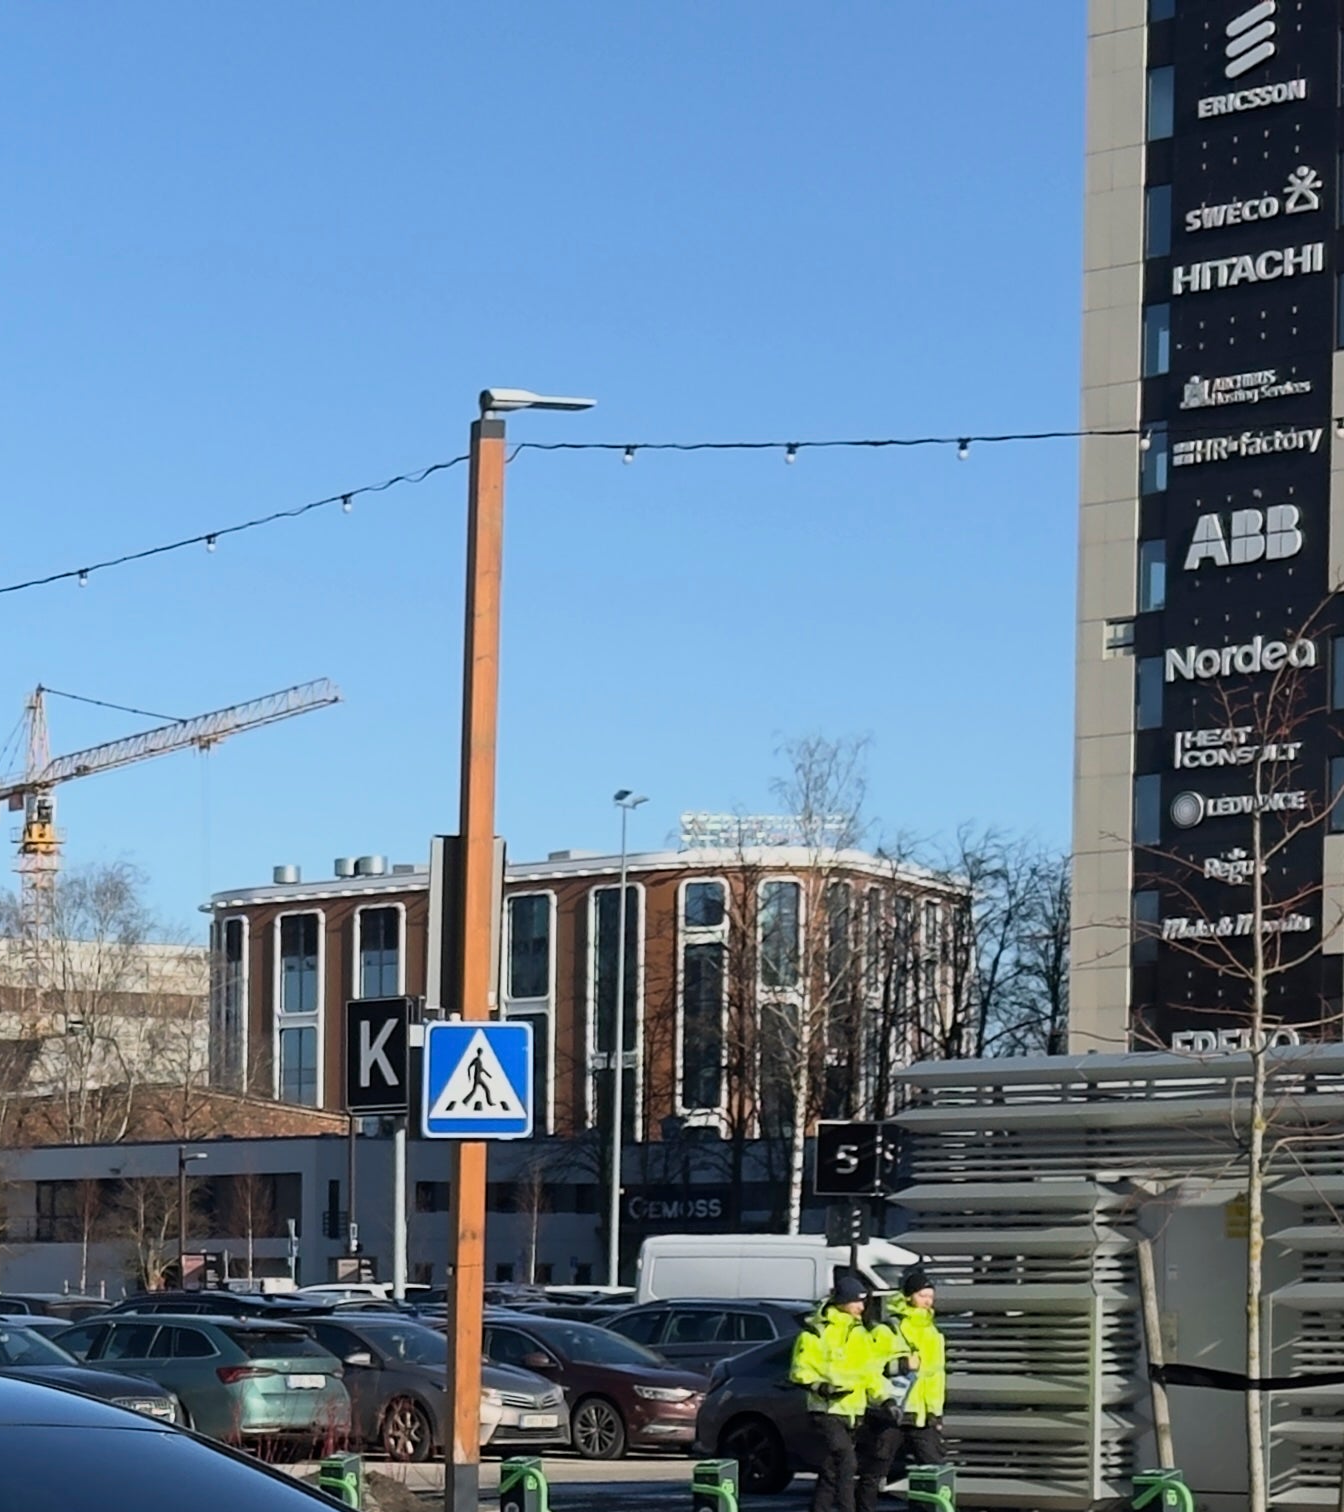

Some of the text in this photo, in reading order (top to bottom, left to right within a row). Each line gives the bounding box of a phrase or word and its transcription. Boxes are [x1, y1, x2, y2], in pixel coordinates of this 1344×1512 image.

[1198, 79, 1306, 119] ERICSSON
[1185, 197, 1279, 232] SWECO
[1172, 242, 1324, 295] HITACHI
[1184, 504, 1303, 570] ABB
[1165, 635, 1316, 682] Nordea
[1184, 726, 1253, 749] HEAT
[359, 1018, 399, 1088] K
[836, 1144, 858, 1174] 5
[628, 1196, 723, 1219] GEMOSS
